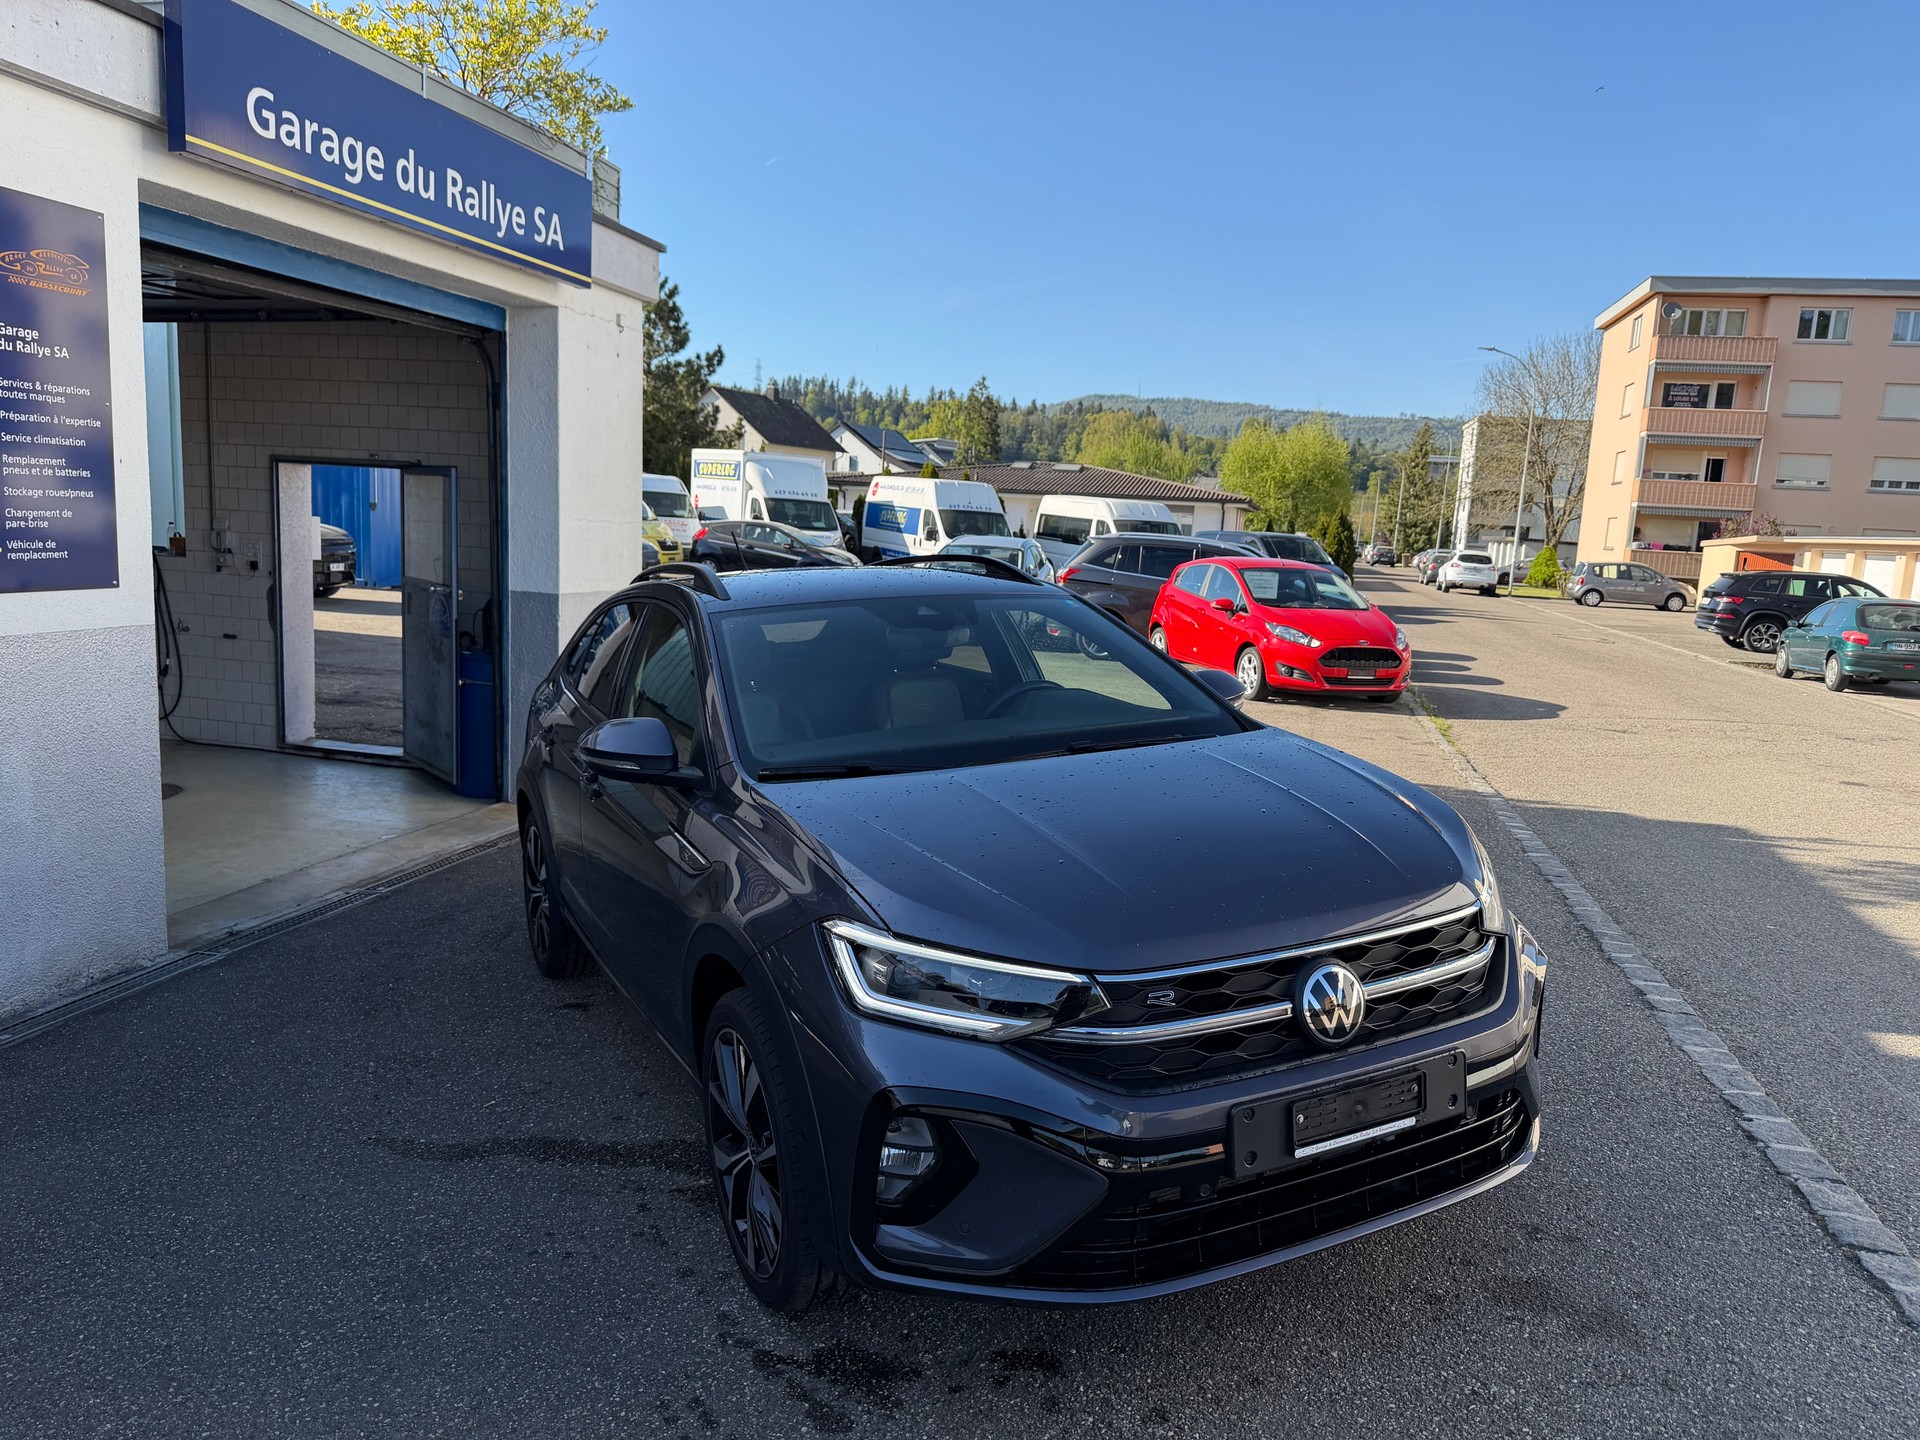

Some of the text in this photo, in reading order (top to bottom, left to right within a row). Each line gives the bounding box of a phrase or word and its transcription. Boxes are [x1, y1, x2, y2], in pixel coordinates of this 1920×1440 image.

[247, 87, 564, 251] Garage du Rallye SA
[29, 280, 88, 296] BASSECOURT
[0, 322, 39, 341] Garage
[16, 340, 51, 358] Rallye
[54, 346, 70, 359] SA
[0, 377, 91, 396] Services & réparations
[0, 389, 66, 404] toutes marques
[0, 410, 101, 428] Préparation à l'expertise
[1, 432, 86, 447] Service climatisation
[2, 454, 66, 466] Remplacement
[3, 466, 91, 478] pneus et de batteries
[3, 486, 94, 499] Stockage roues/pneus
[5, 507, 73, 520] Changement de
[5, 518, 49, 530] pare-brise
[6, 539, 57, 550] Véhicule de
[7, 550, 69, 562] remplacement
